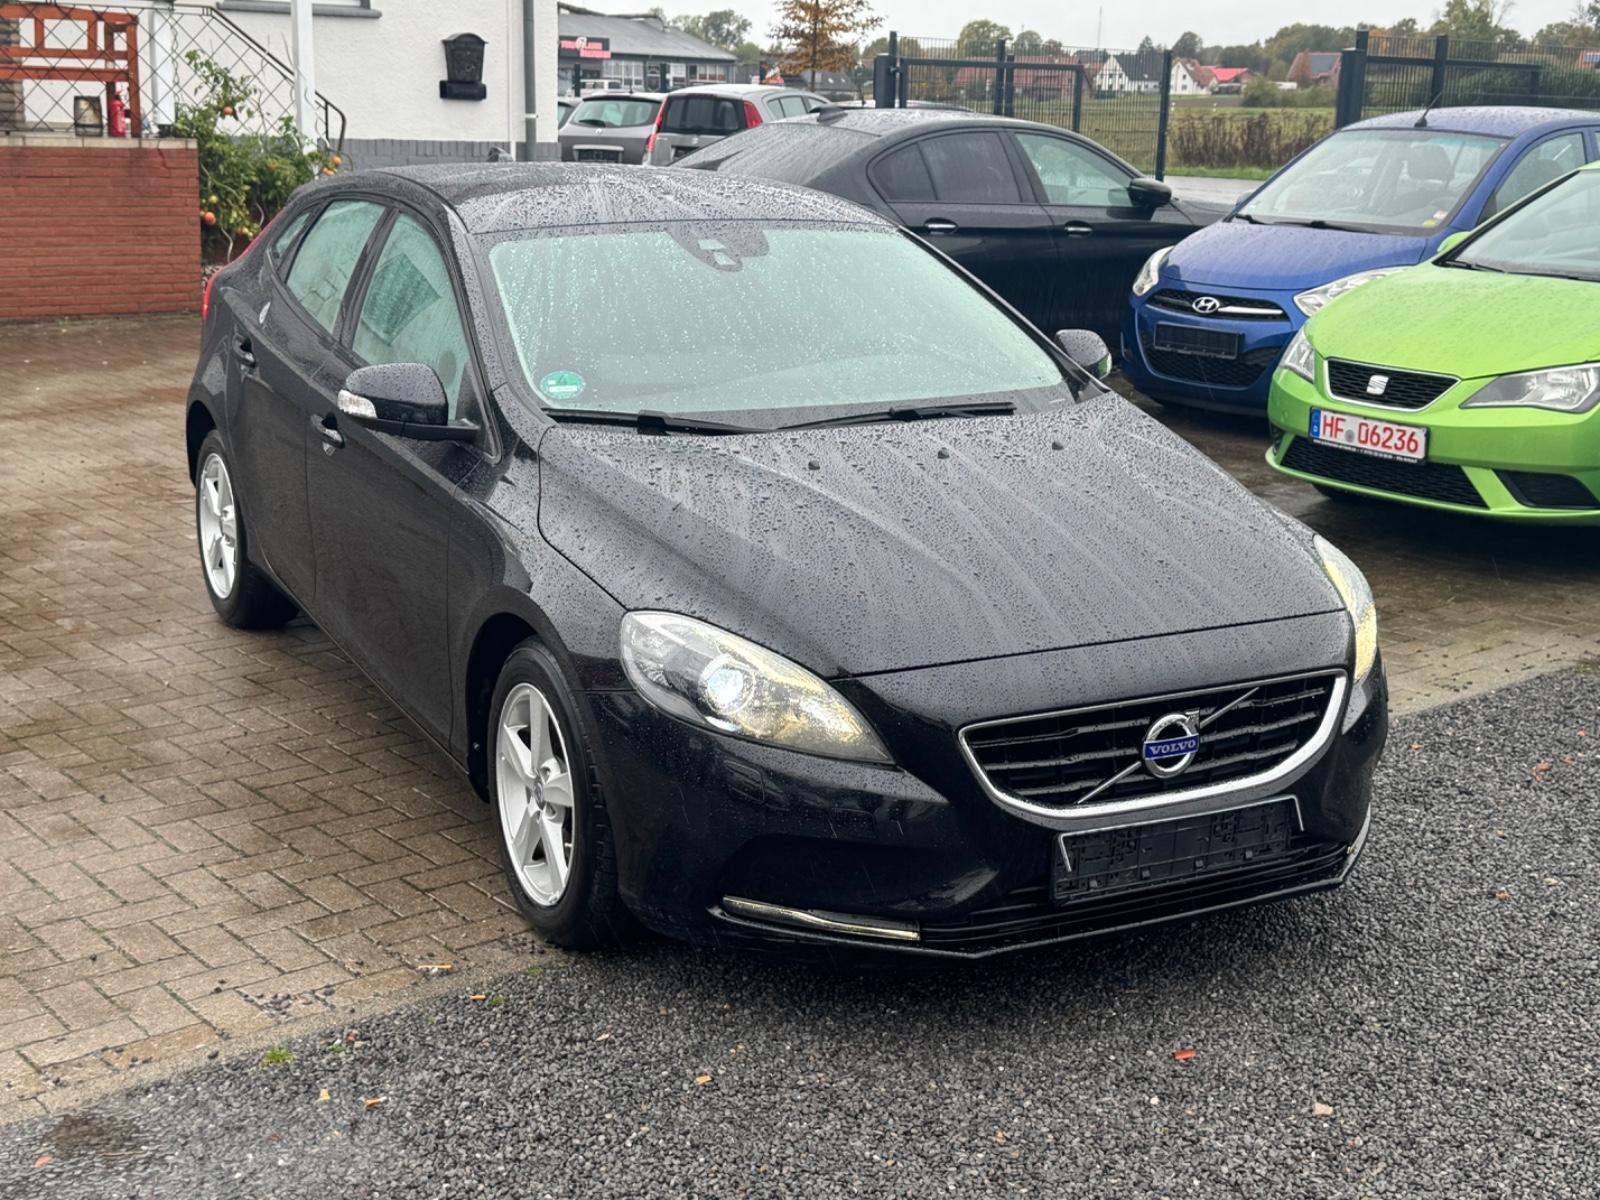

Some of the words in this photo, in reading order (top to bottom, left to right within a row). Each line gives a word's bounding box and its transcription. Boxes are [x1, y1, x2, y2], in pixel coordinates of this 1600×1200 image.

[1322, 414, 1346, 439] HF
[1358, 421, 1419, 453] 06236
[1149, 739, 1196, 755] VOLVO
